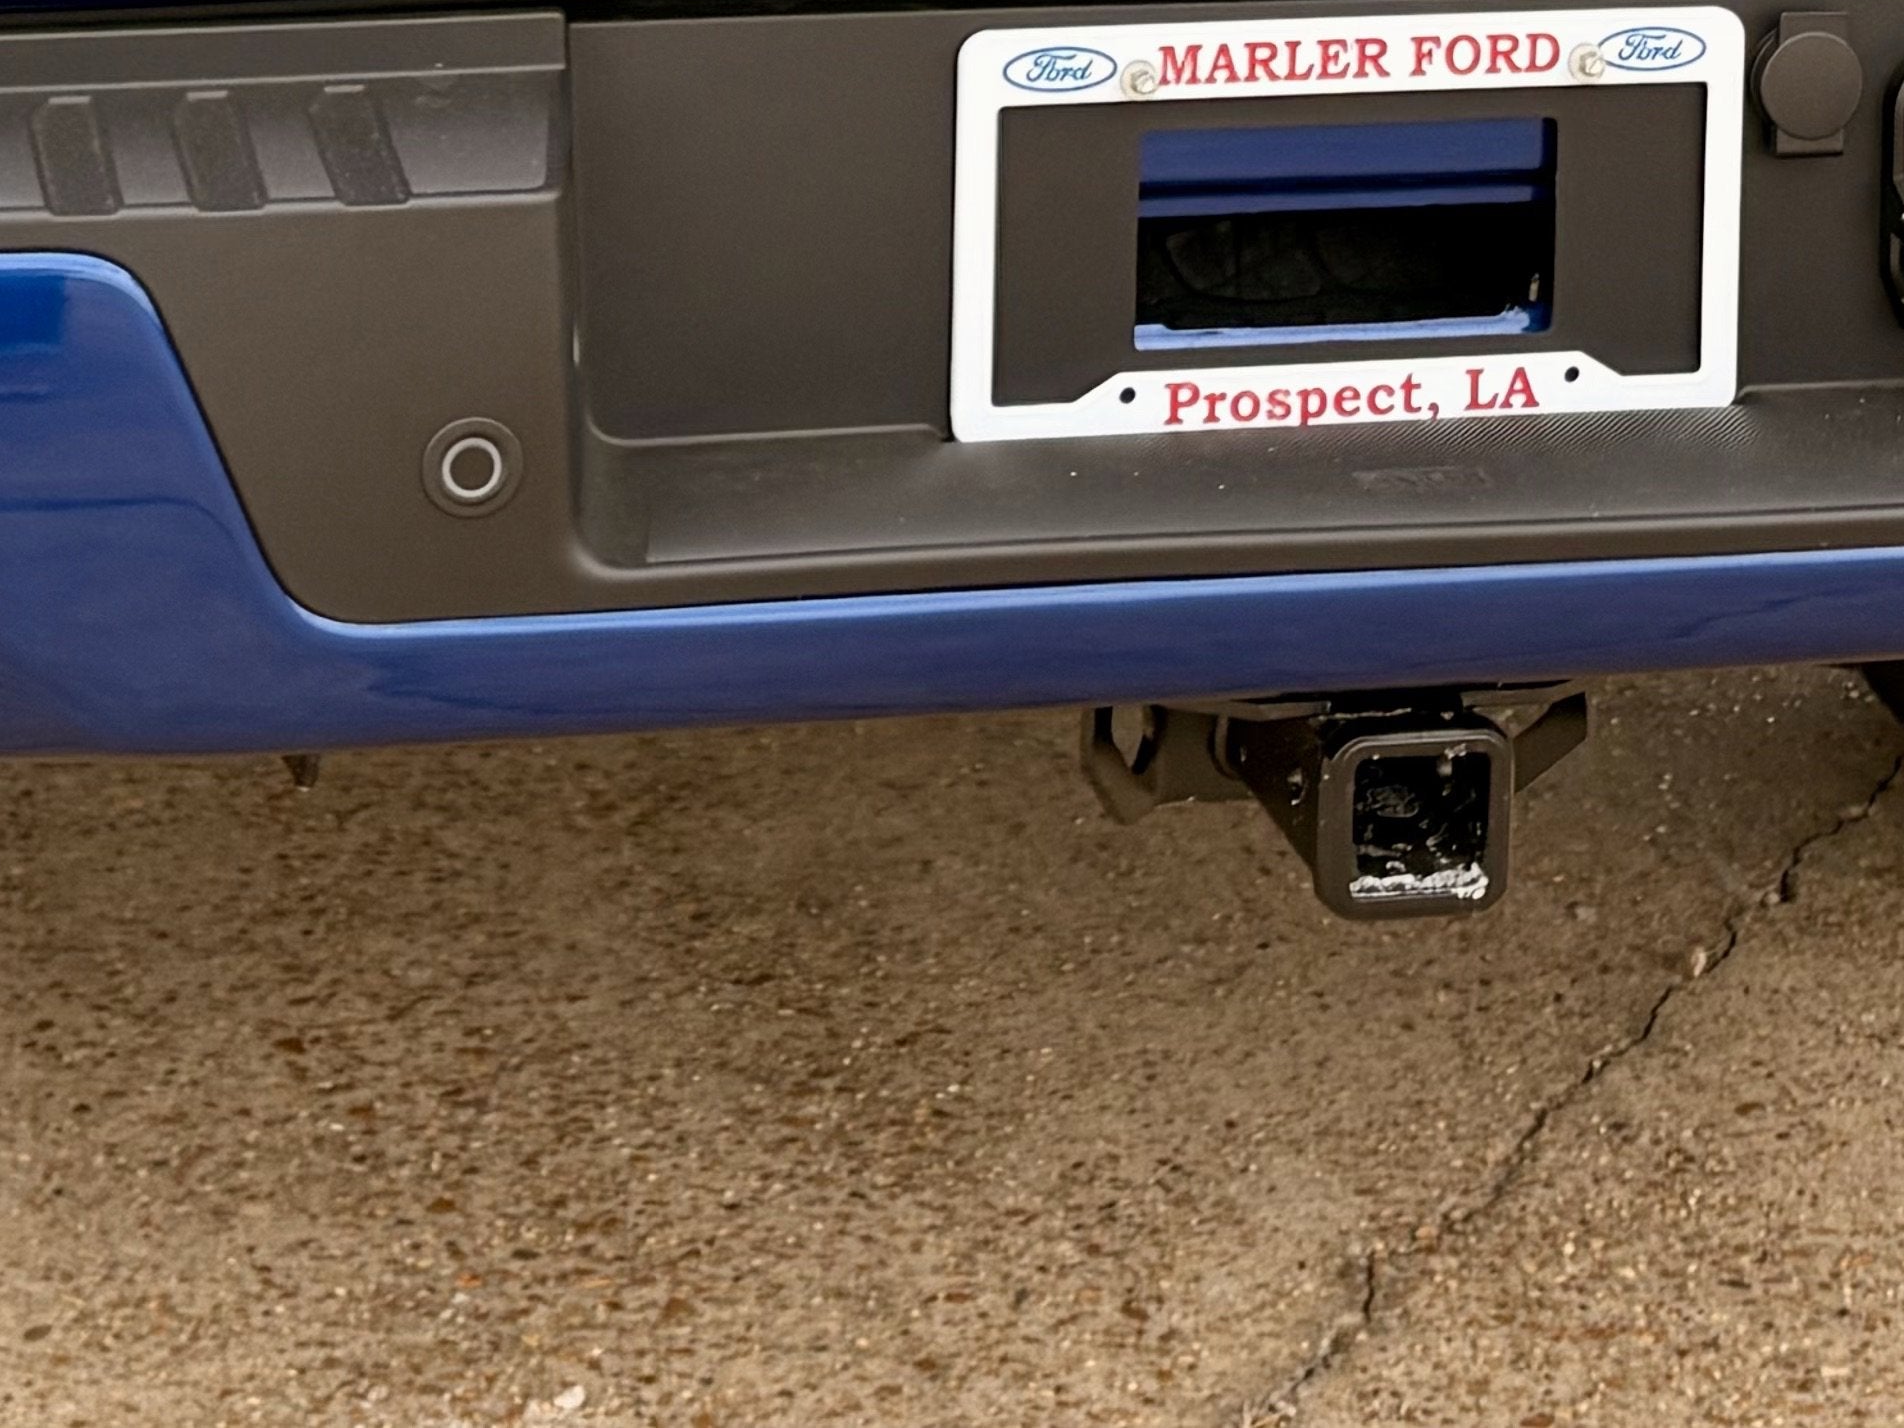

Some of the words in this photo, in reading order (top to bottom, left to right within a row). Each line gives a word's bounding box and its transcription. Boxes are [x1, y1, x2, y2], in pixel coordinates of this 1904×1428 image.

[1026, 52, 1094, 82] Ford
[1158, 37, 1391, 86] MARLER
[1409, 32, 1561, 77] FORD
[1618, 33, 1684, 61] Ford
[1164, 372, 1440, 426] Prospect,
[1465, 366, 1540, 411] LA
